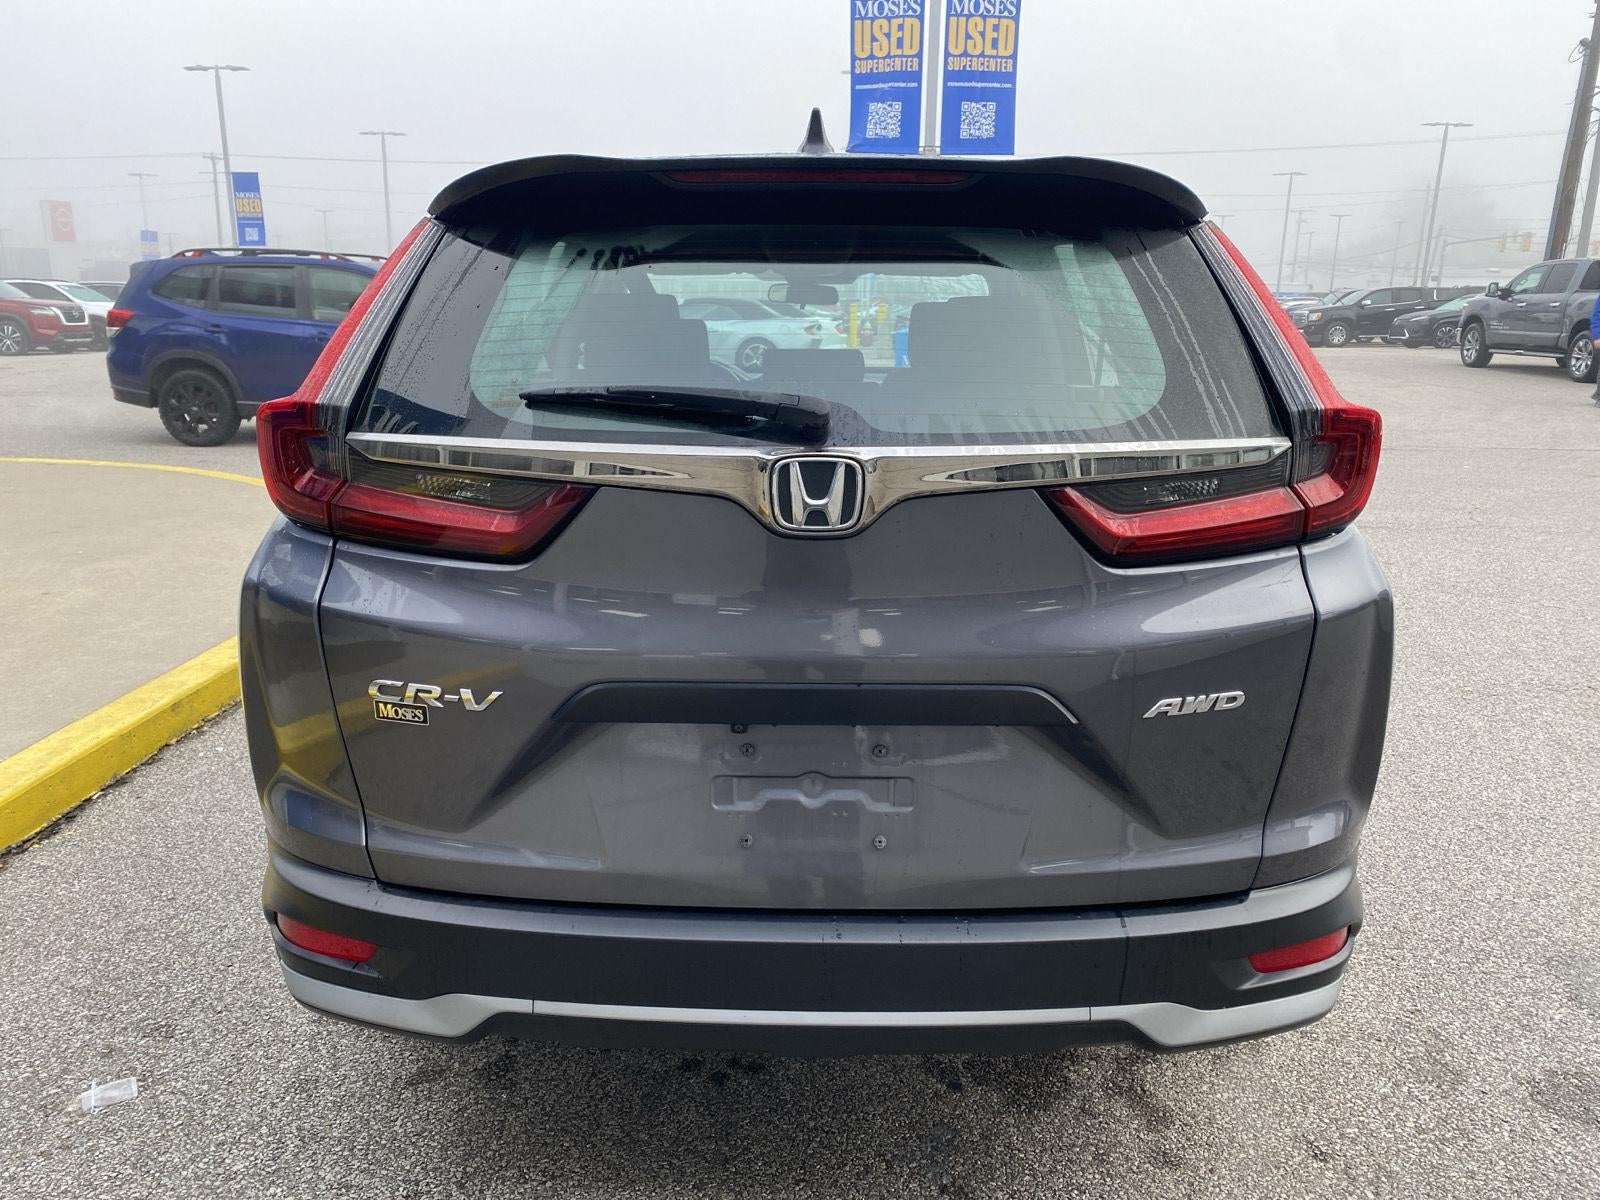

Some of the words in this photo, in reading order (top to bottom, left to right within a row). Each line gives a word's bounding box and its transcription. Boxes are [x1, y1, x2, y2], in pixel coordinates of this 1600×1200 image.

[855, 0, 921, 17] MOSES
[951, 0, 1017, 16] MOSES
[854, 18, 921, 58] USED
[948, 16, 1016, 56] USED
[855, 58, 919, 74] SUPERCENTER
[947, 57, 1013, 72] SUPERCENTER
[237, 199, 261, 212] USED
[368, 679, 504, 711] CR-V
[378, 703, 424, 722] MOSES
[1142, 690, 1246, 719] AWD
